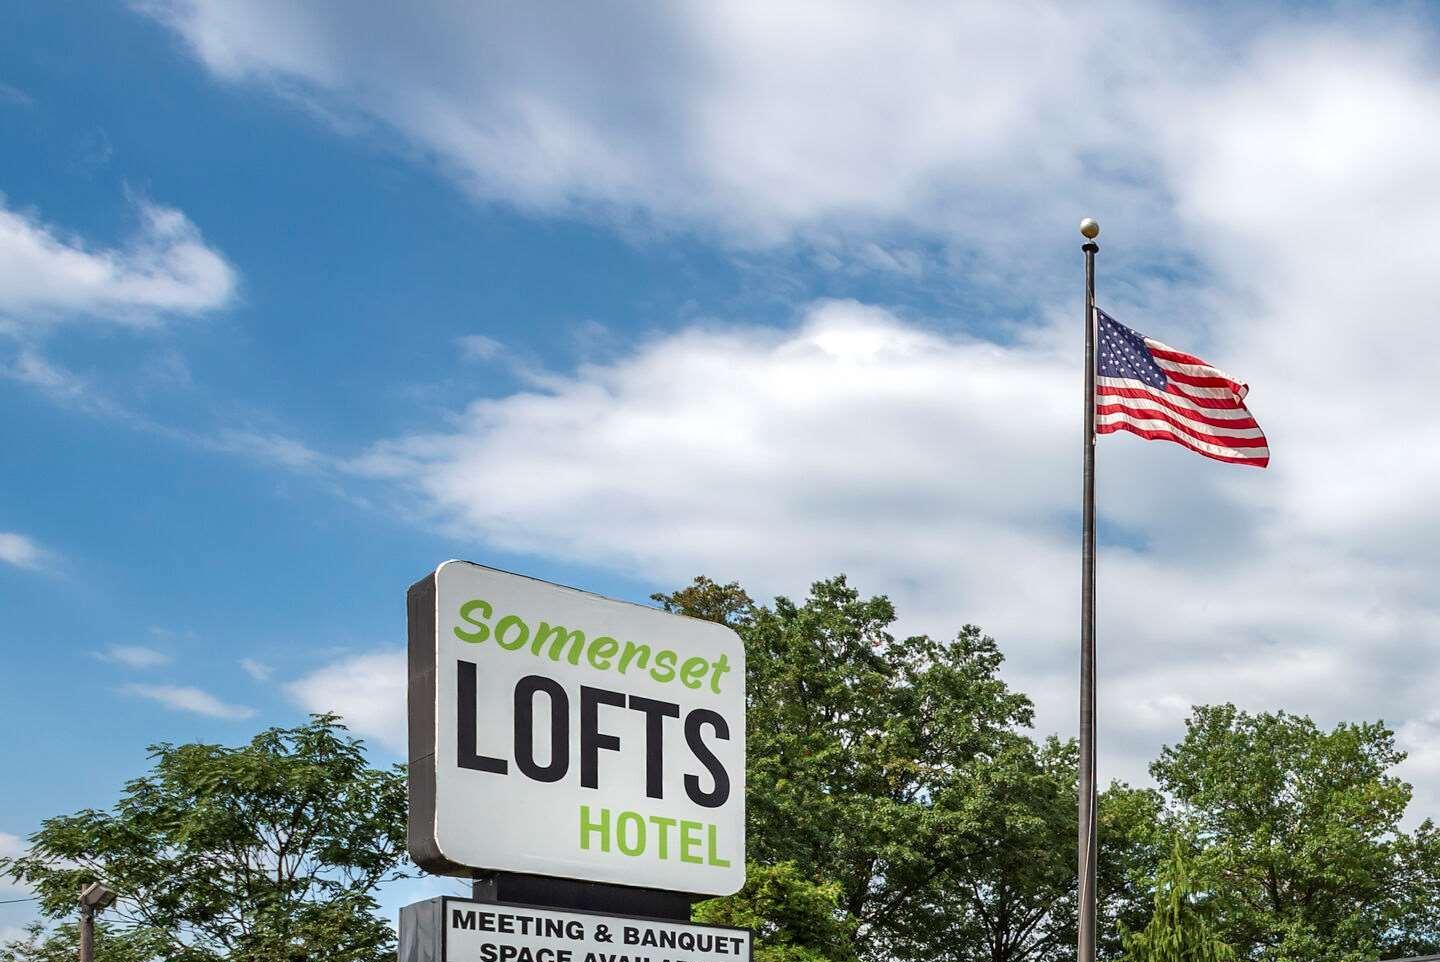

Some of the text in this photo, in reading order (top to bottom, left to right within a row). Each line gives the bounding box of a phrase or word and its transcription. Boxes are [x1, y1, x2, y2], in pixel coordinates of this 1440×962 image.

[453, 600, 730, 694] Somerset
[457, 659, 730, 808] LOFTS
[580, 806, 731, 868] HOTEL
[452, 909, 745, 956] MEETING & BANQUET
